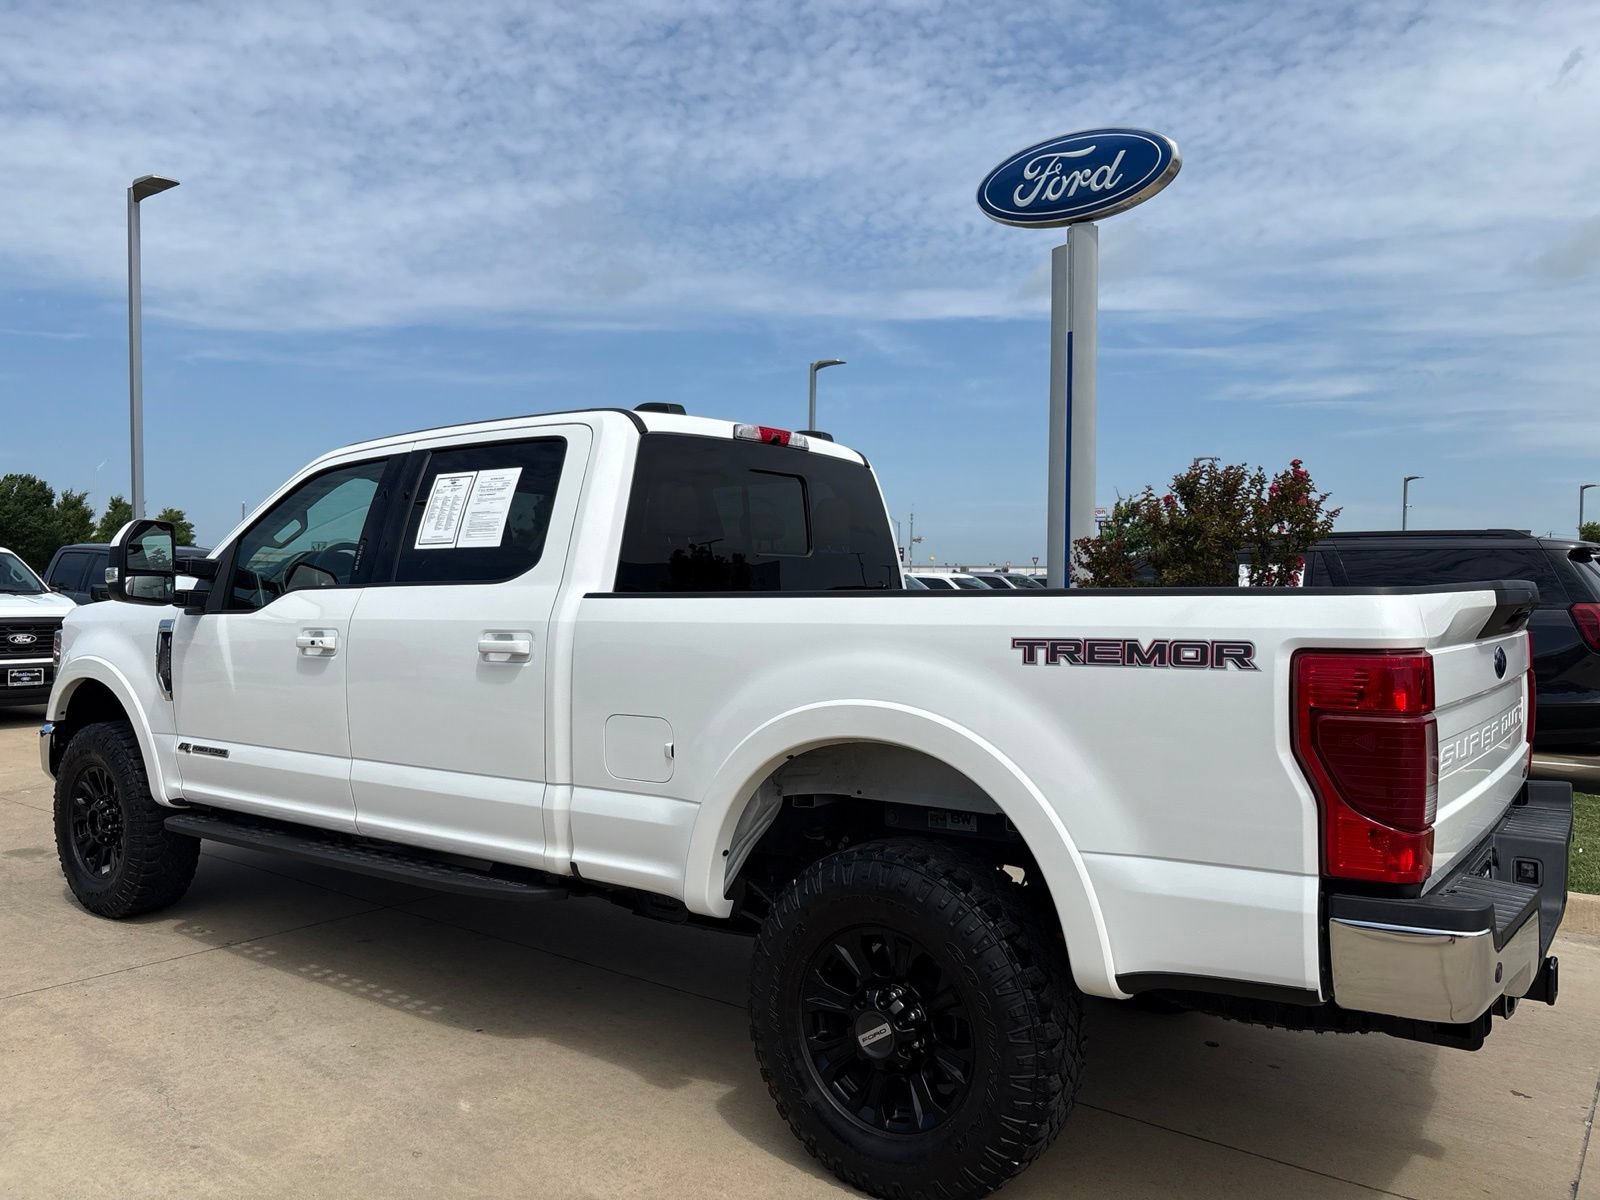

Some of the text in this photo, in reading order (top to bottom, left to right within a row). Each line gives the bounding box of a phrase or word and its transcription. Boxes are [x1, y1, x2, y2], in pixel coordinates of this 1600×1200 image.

[1013, 145, 1126, 207] Ford
[1011, 637, 1262, 672] TREMOR
[1440, 720, 1499, 770] SUPER
[862, 1028, 887, 1043] FORD
